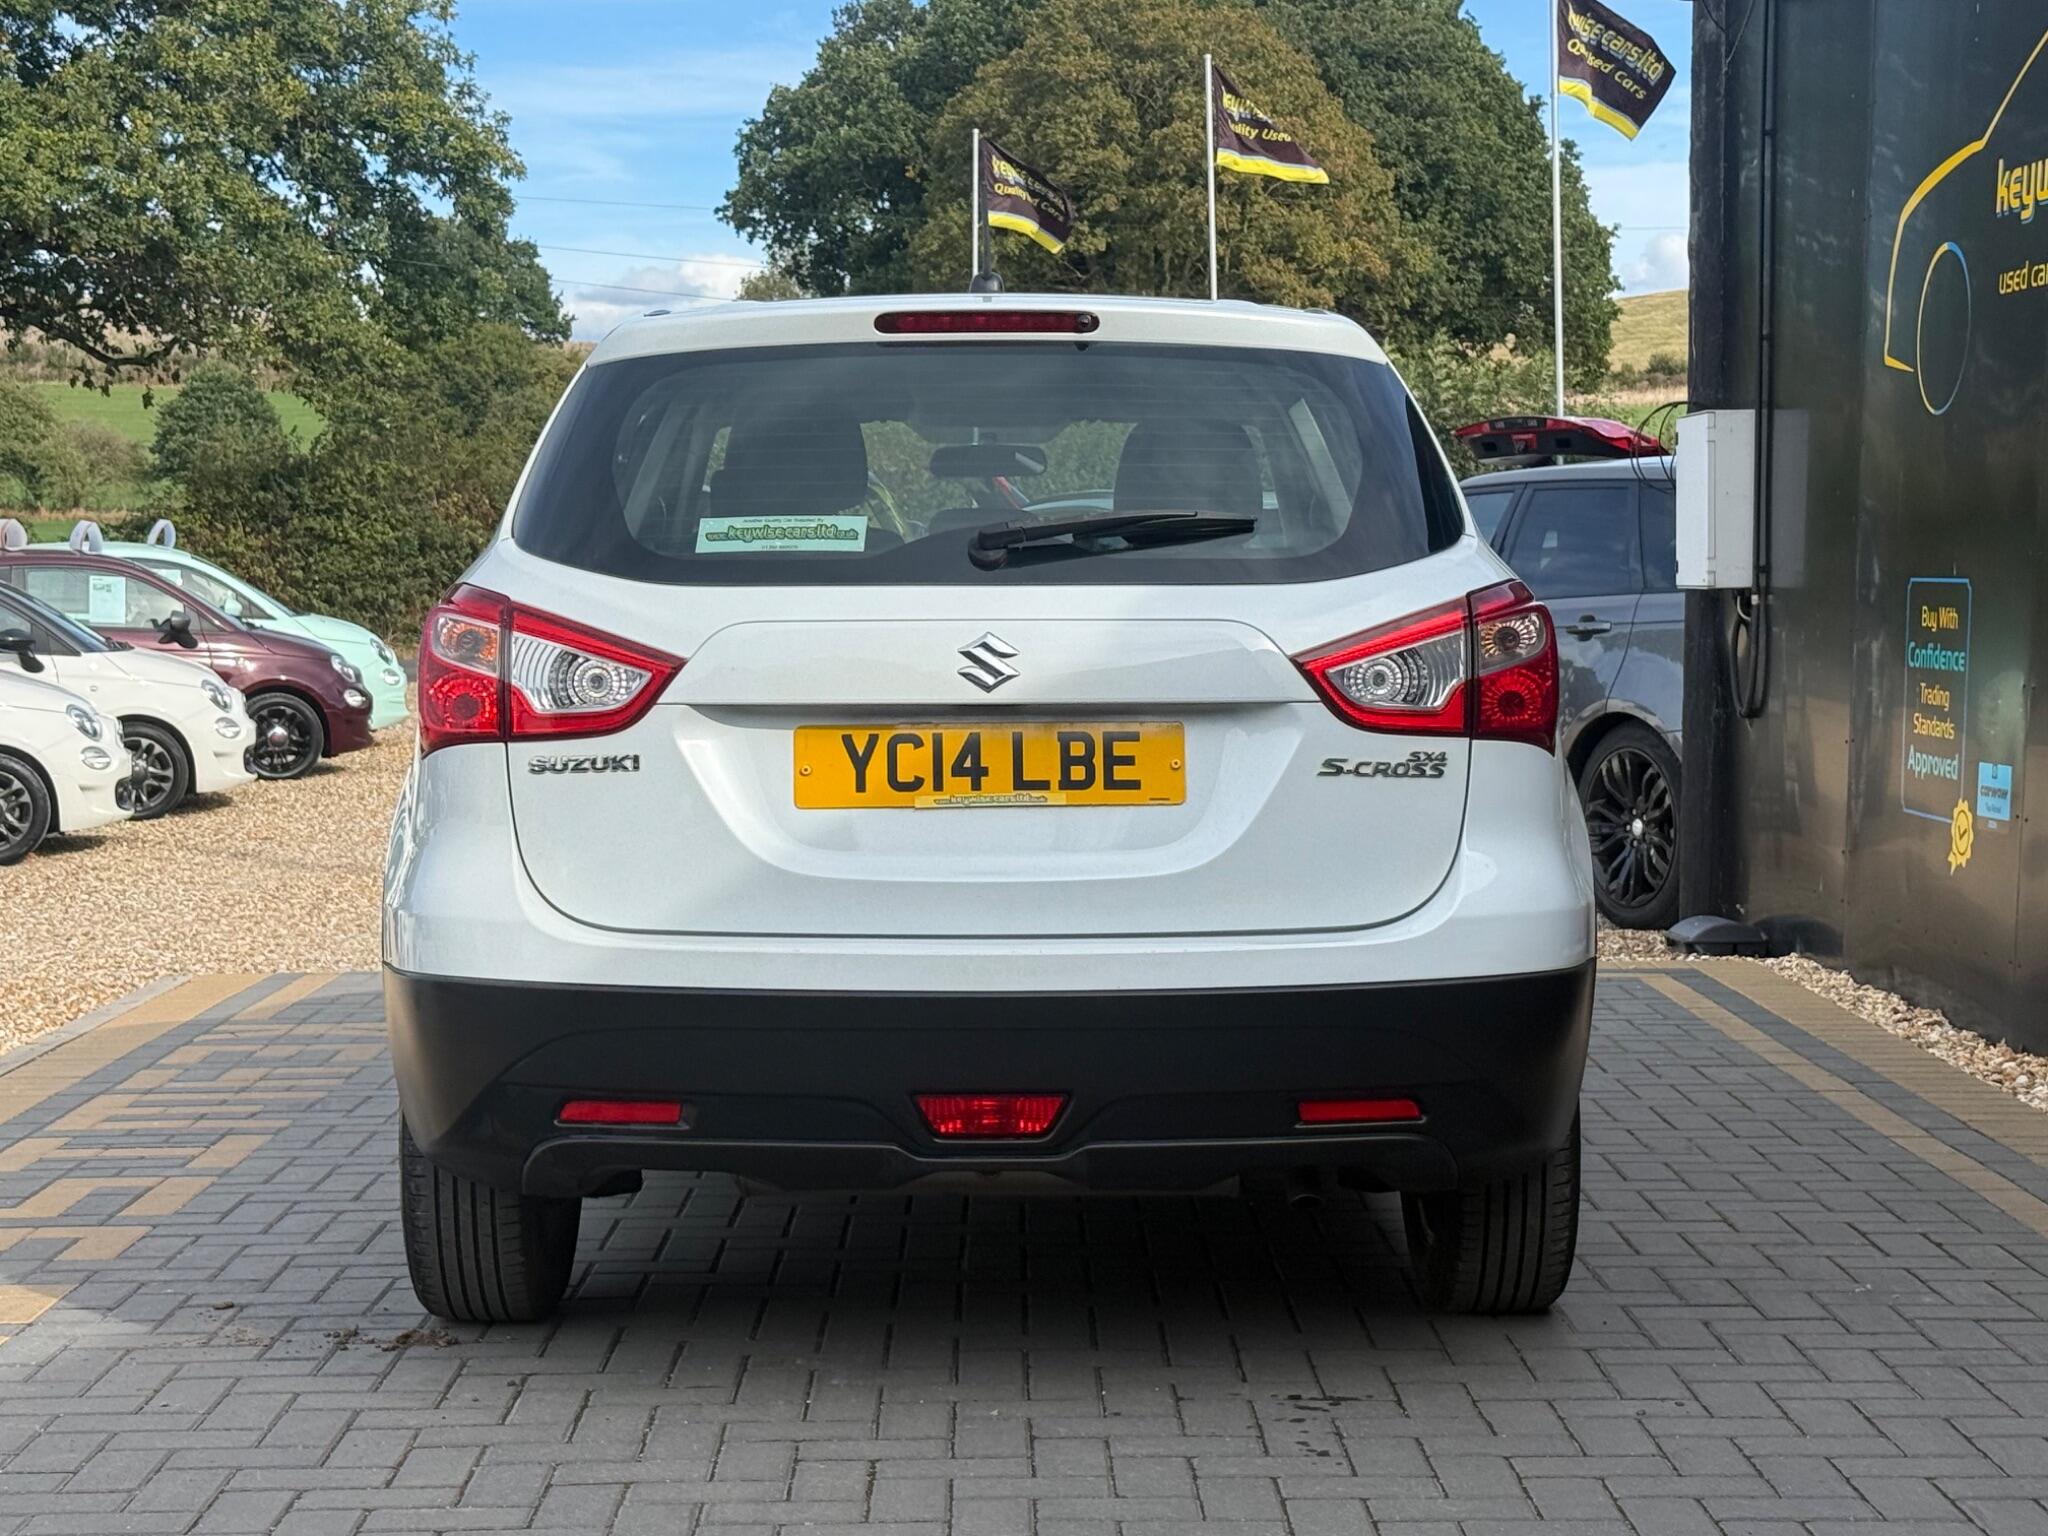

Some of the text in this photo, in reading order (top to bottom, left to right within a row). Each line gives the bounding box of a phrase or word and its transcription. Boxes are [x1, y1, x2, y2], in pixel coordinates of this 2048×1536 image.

[1999, 260, 2028, 295] used
[1921, 605, 1959, 632] Buy With
[1908, 641, 1966, 672] Confidence
[1920, 682, 1951, 712] Trading
[1913, 712, 1955, 740] Standards
[528, 754, 640, 774] SUZUKI
[841, 731, 1142, 793] YC14 LBE
[1406, 751, 1447, 762] SX4
[1907, 745, 1959, 781] Approved
